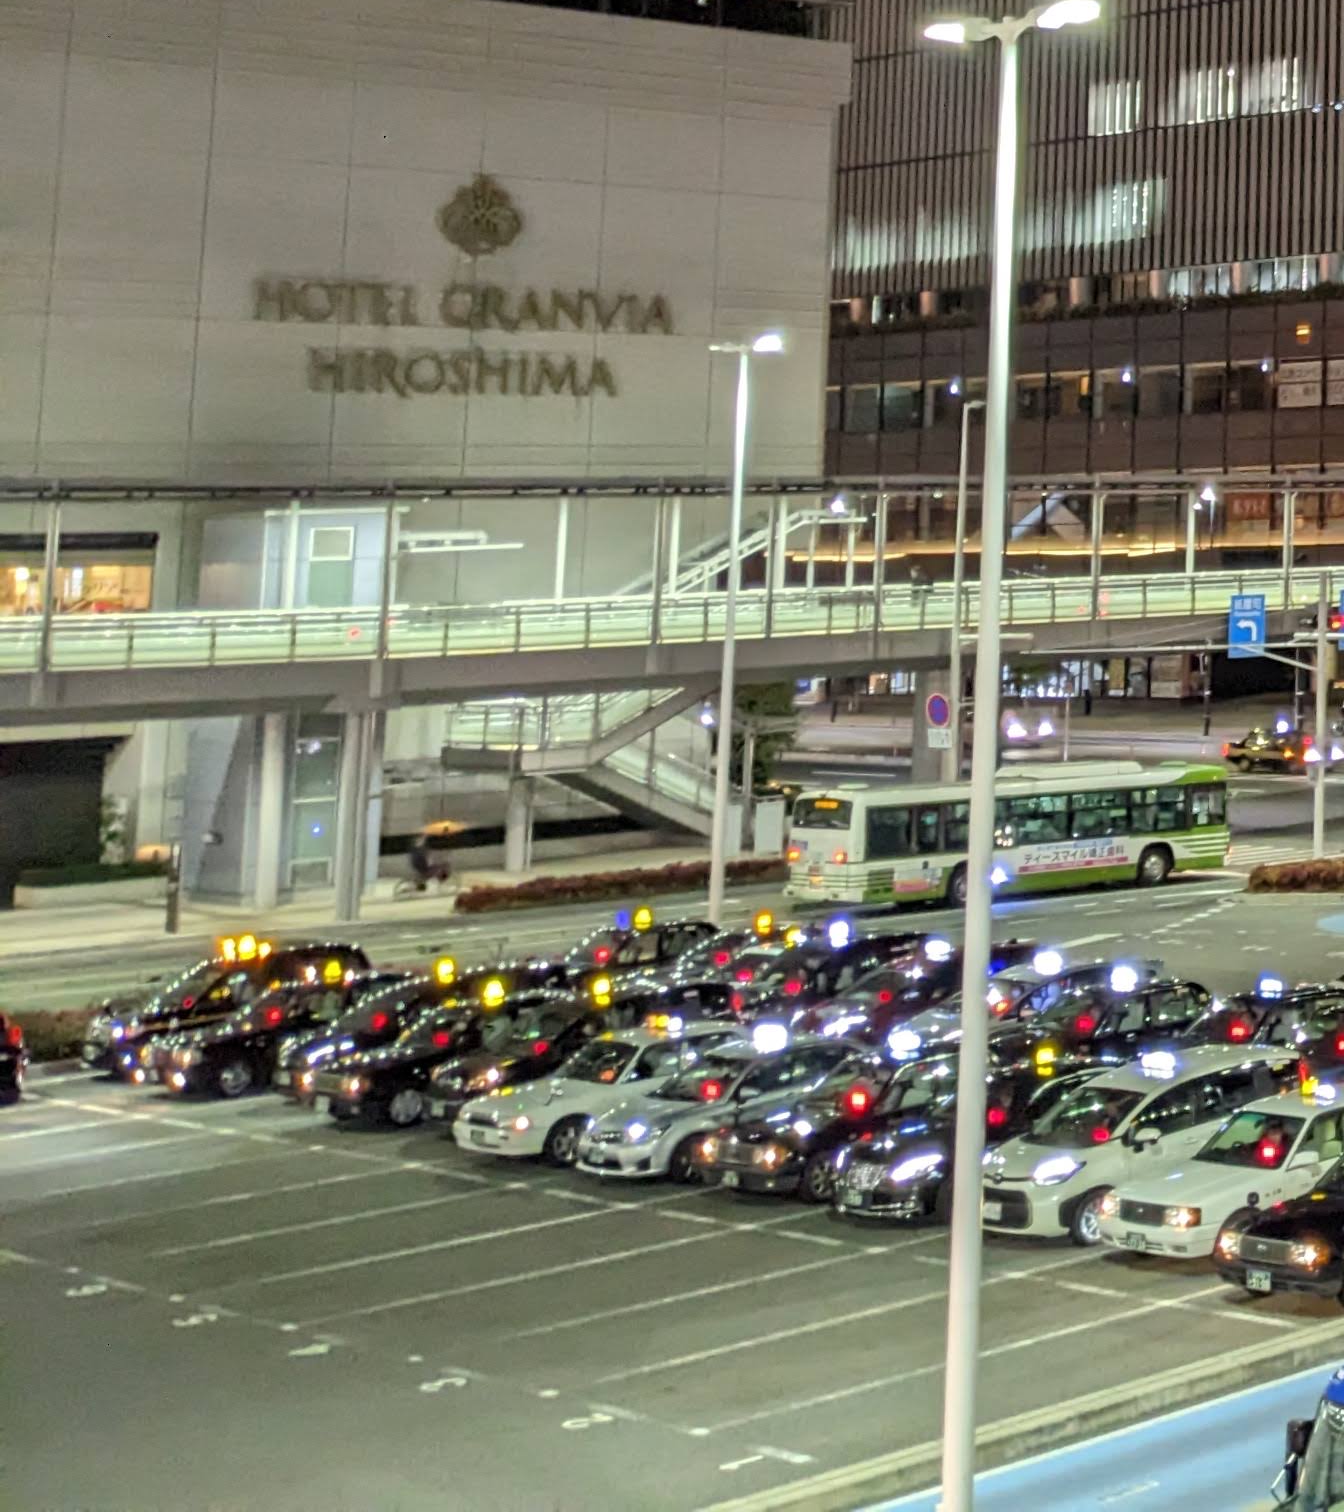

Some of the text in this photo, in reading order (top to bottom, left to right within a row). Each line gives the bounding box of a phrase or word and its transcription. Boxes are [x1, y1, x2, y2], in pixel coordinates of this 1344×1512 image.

[253, 277, 675, 335] HOTEL GRANVIA
[308, 345, 619, 398] HIROSHIMA
